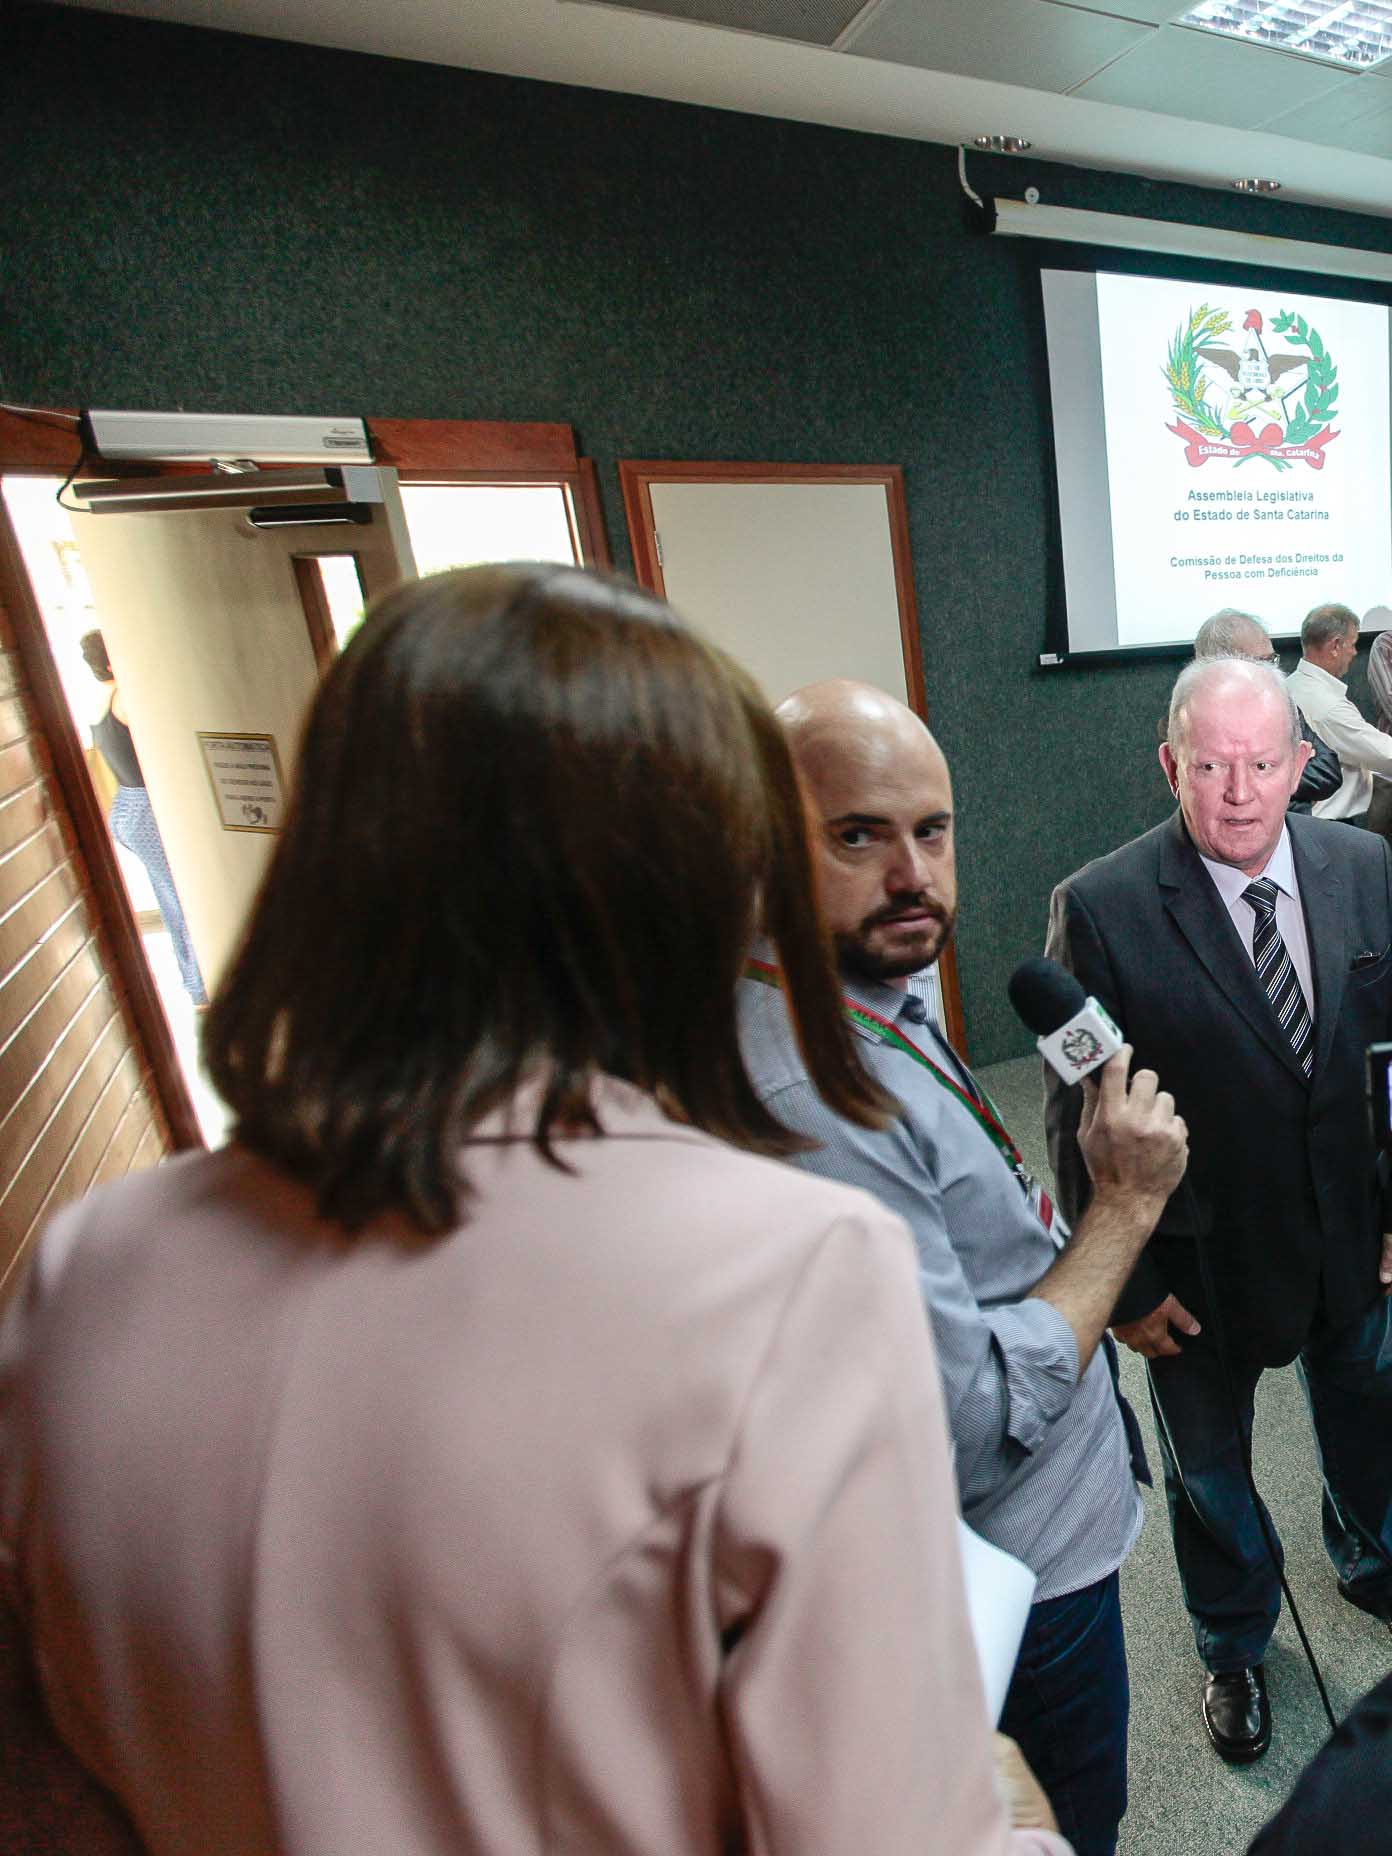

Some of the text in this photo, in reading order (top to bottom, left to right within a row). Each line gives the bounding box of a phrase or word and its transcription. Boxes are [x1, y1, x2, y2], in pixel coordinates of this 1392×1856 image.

[1187, 490, 1314, 503] Assembleia Legislativa
[1174, 508, 1329, 521] do Estado de Santa Catarina
[1170, 552, 1344, 567] Comissão de Defesa dos Direitos da
[1204, 566, 1319, 580] Pessoa com Deficiência
